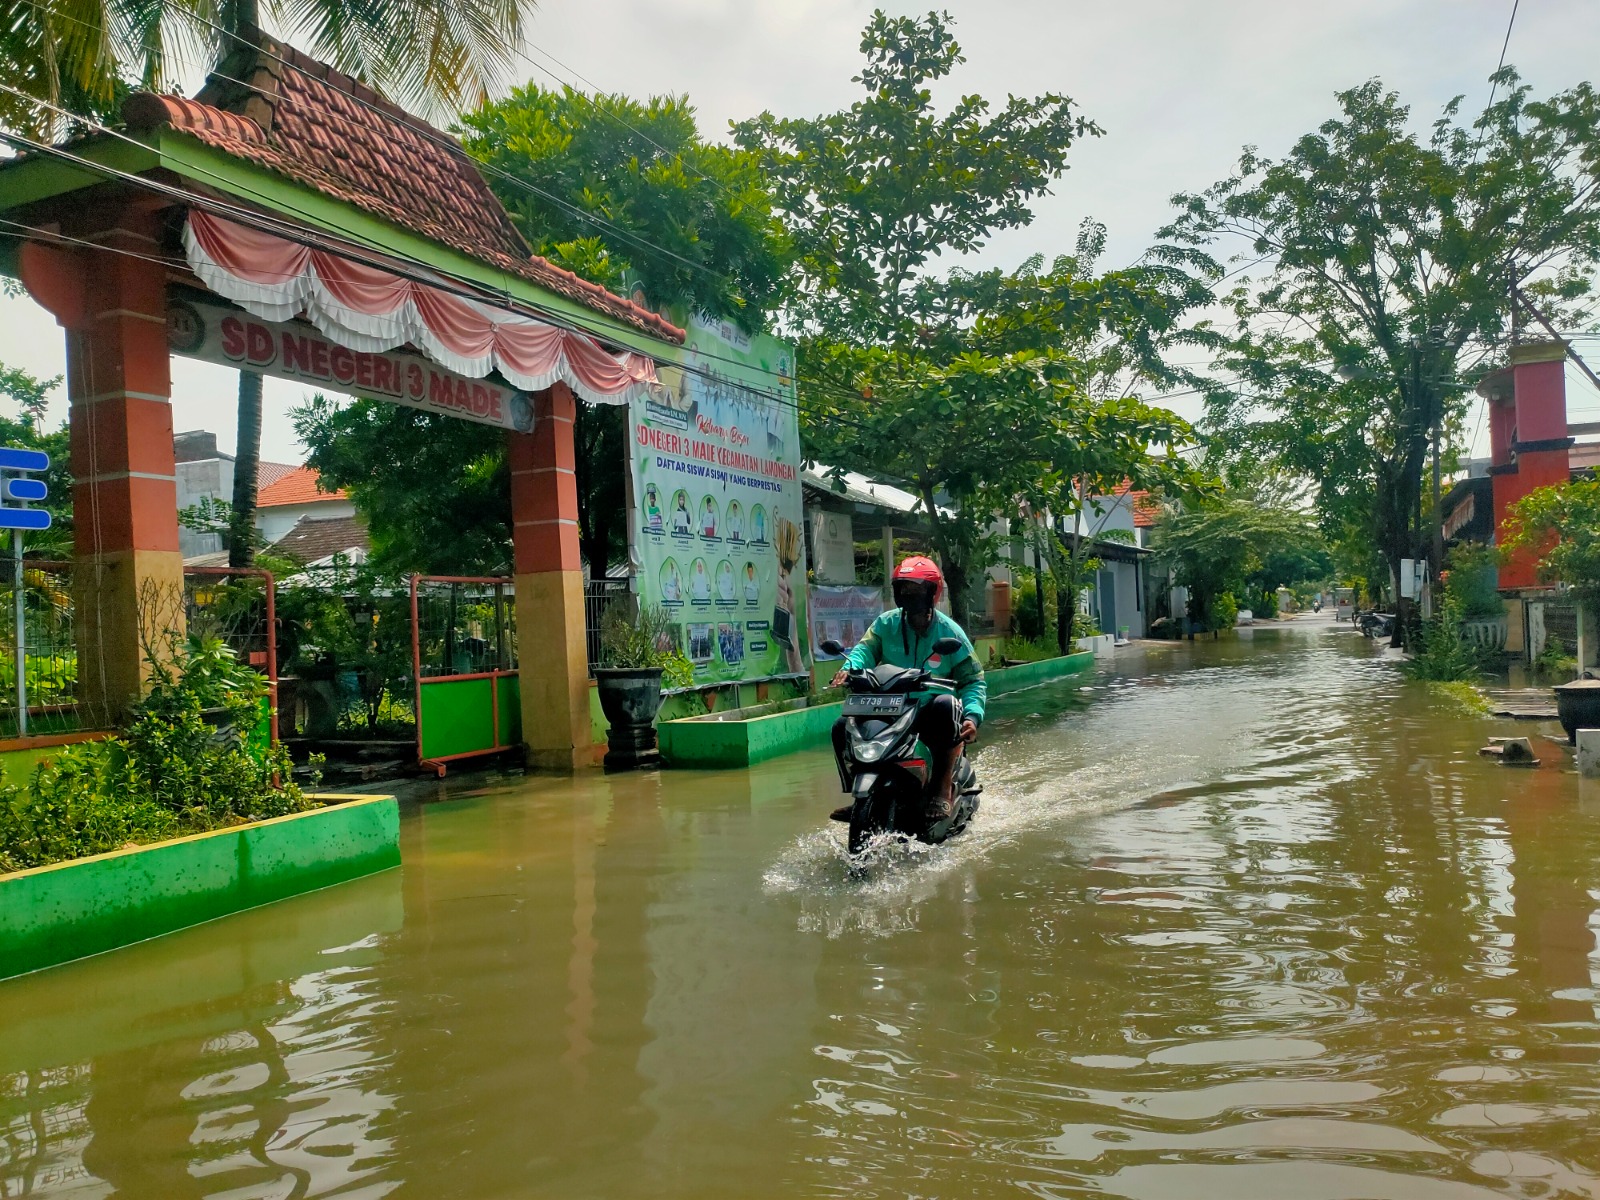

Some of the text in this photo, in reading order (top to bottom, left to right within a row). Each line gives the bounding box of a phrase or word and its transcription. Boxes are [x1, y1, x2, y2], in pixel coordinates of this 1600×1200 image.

[220, 316, 503, 423] SD NEGERI 3 MADE
[684, 437, 690, 457] 3
[656, 456, 686, 473] DAFTAR
[729, 473, 746, 486] YANG
[747, 477, 782, 493] BERPRESTASI
[848, 697, 854, 705] L
[889, 697, 902, 705] HE
